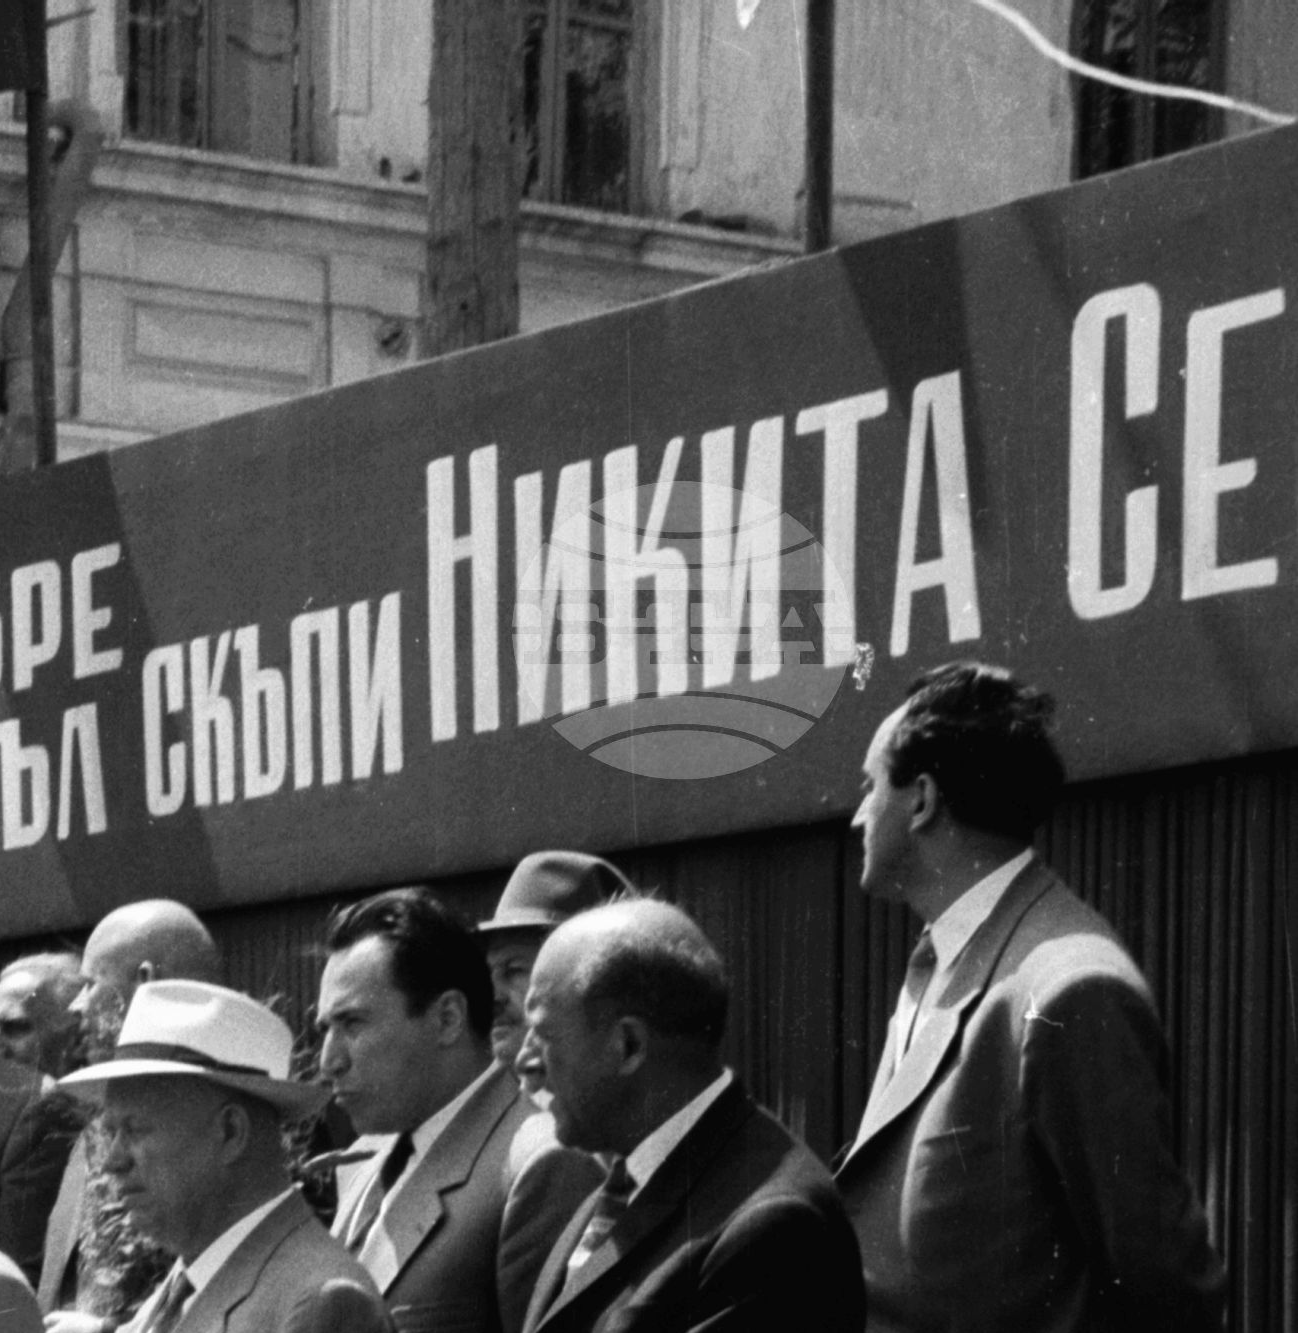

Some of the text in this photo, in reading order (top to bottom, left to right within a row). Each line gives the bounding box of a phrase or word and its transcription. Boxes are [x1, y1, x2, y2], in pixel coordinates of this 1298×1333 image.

[141, 589, 404, 817] СКЪПИ
[425, 368, 982, 744] НИКИТА
[1066, 281, 1286, 621] СЕ
